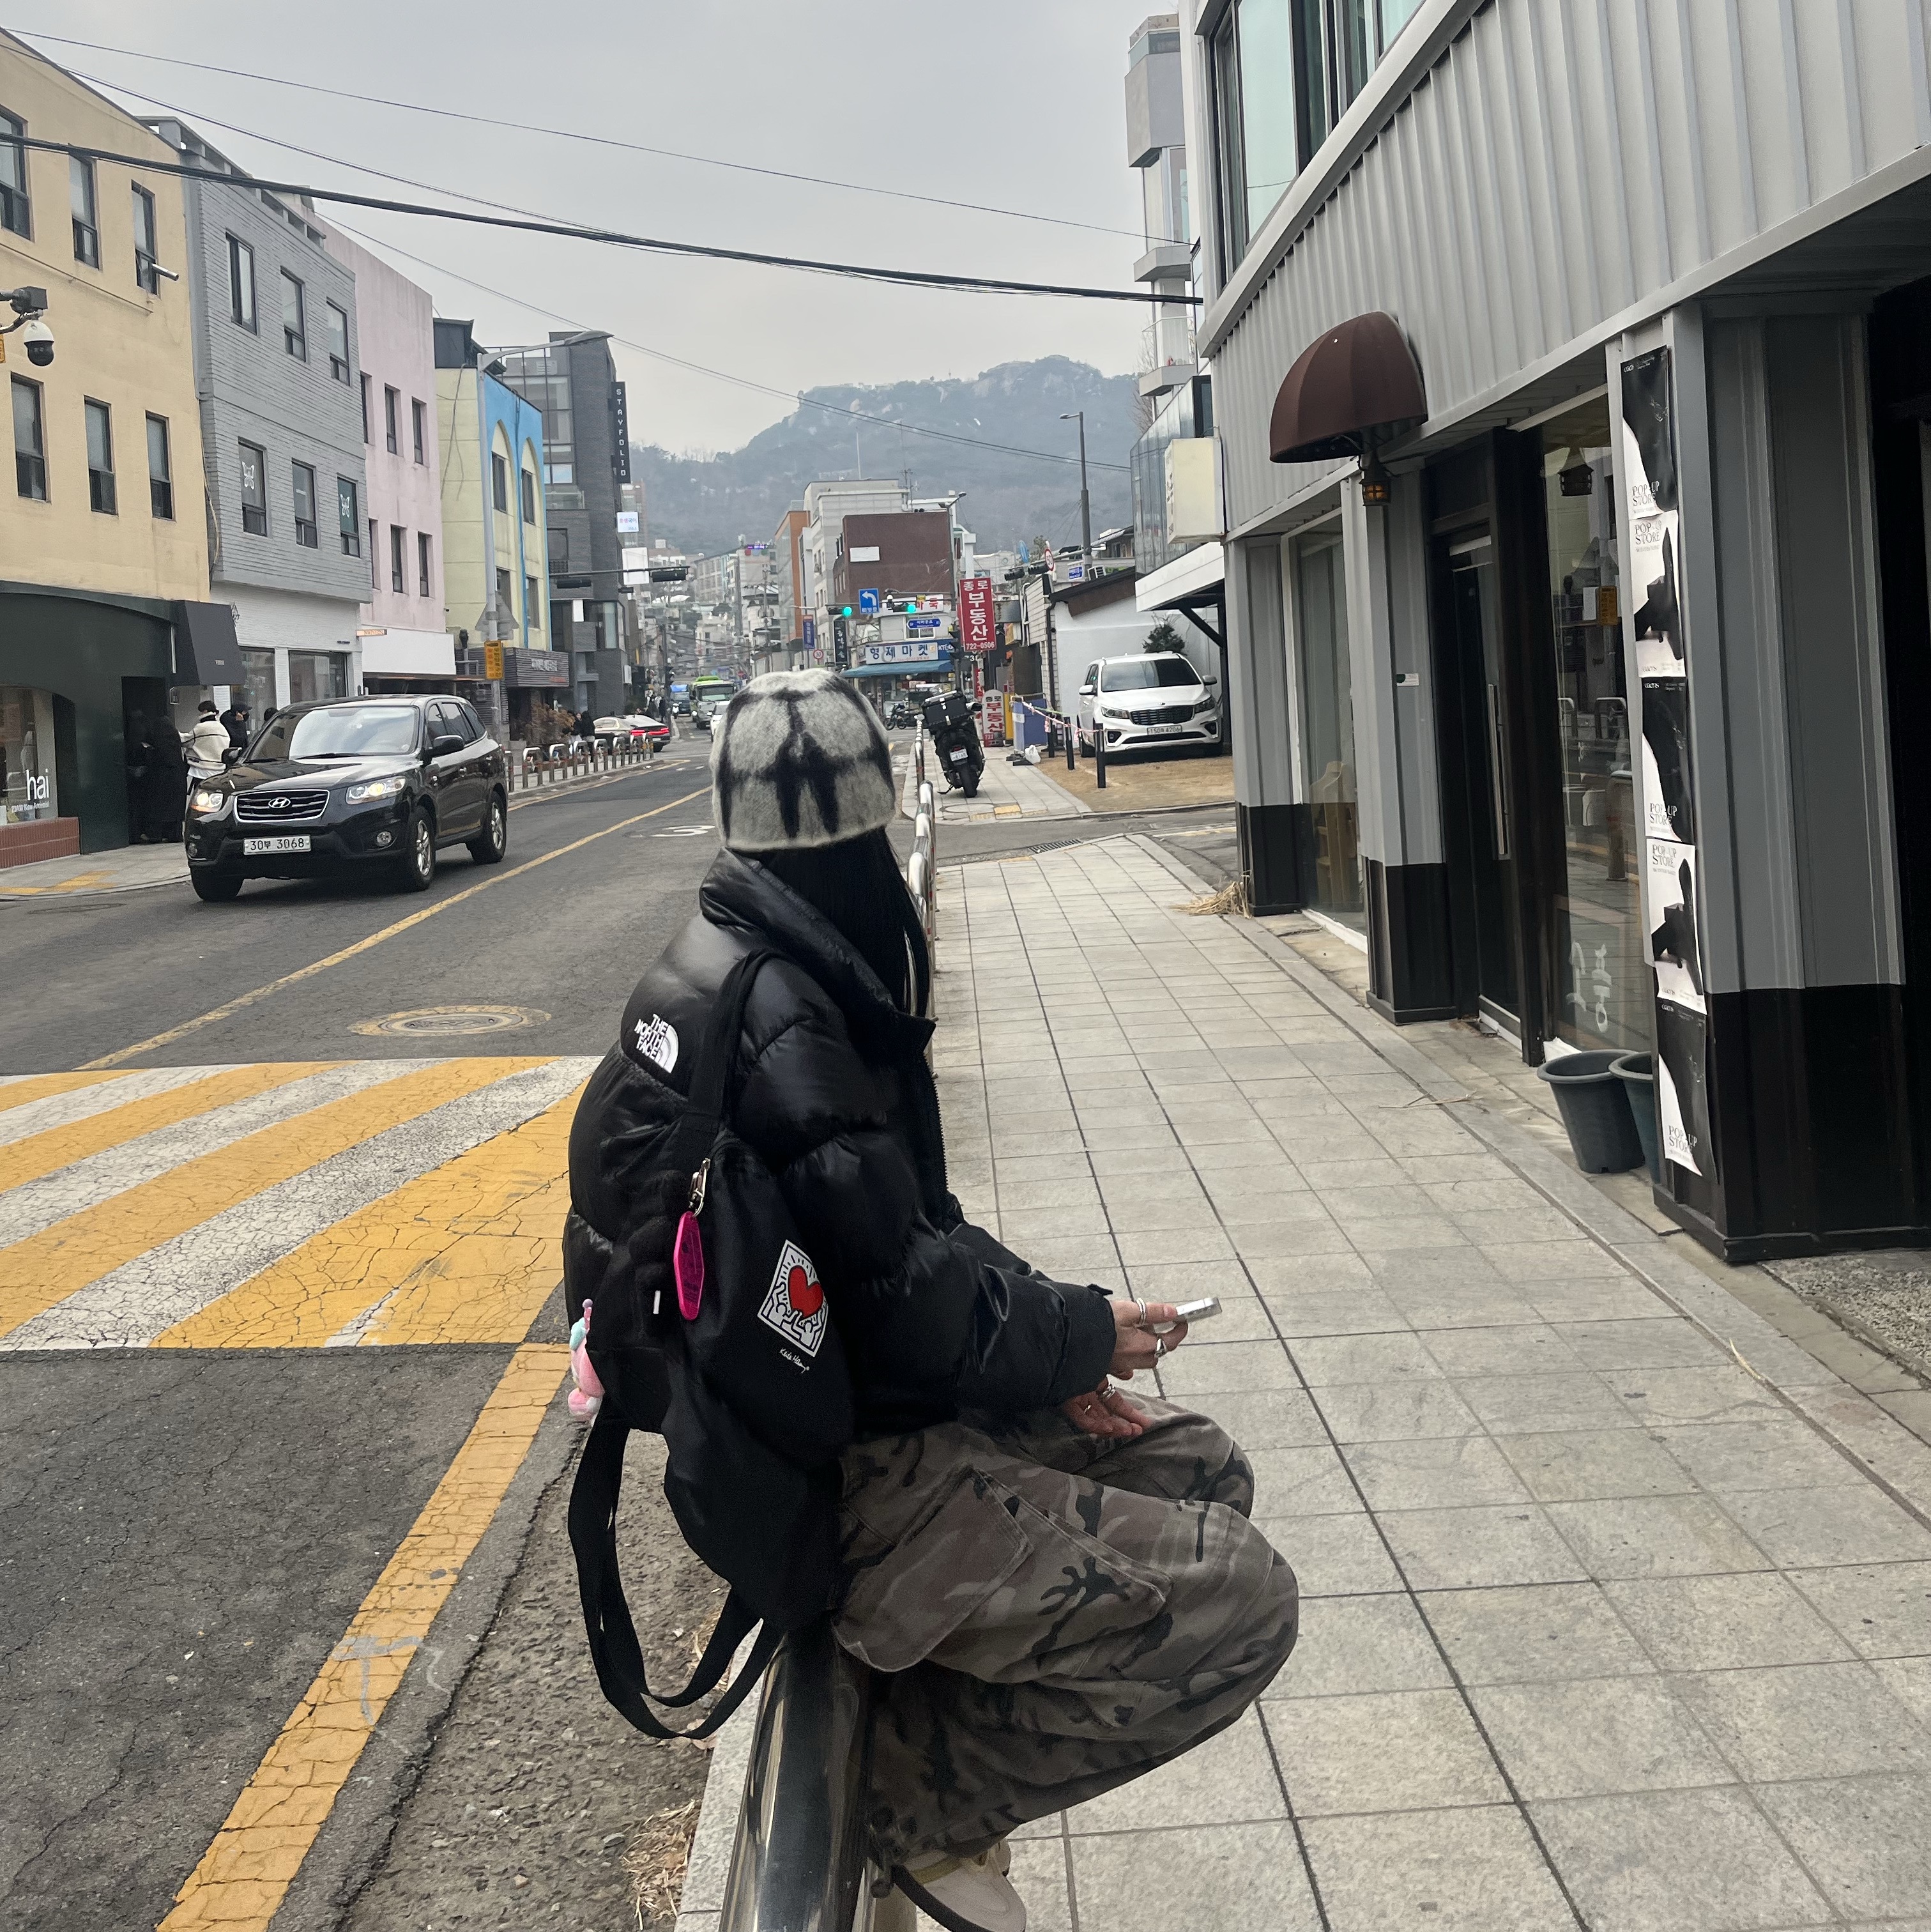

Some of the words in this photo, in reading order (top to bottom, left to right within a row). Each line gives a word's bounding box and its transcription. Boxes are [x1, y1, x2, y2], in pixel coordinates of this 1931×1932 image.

[616, 388, 626, 477] STAYFOLIO
[1632, 480, 1660, 496] POP-UP
[1635, 532, 1660, 545] STORE
[963, 580, 989, 592] 종로
[968, 592, 988, 641] 부동산
[966, 641, 995, 650] 722-0506
[26, 769, 49, 801] hai
[1650, 802, 1677, 816] POP-UP
[277, 838, 304, 849] 3068
[1652, 844, 1677, 858] POP-UP
[1652, 855, 1675, 868] STORE
[650, 1013, 669, 1036] THE
[634, 1018, 664, 1050] NORTH
[636, 1035, 658, 1060] FACE
